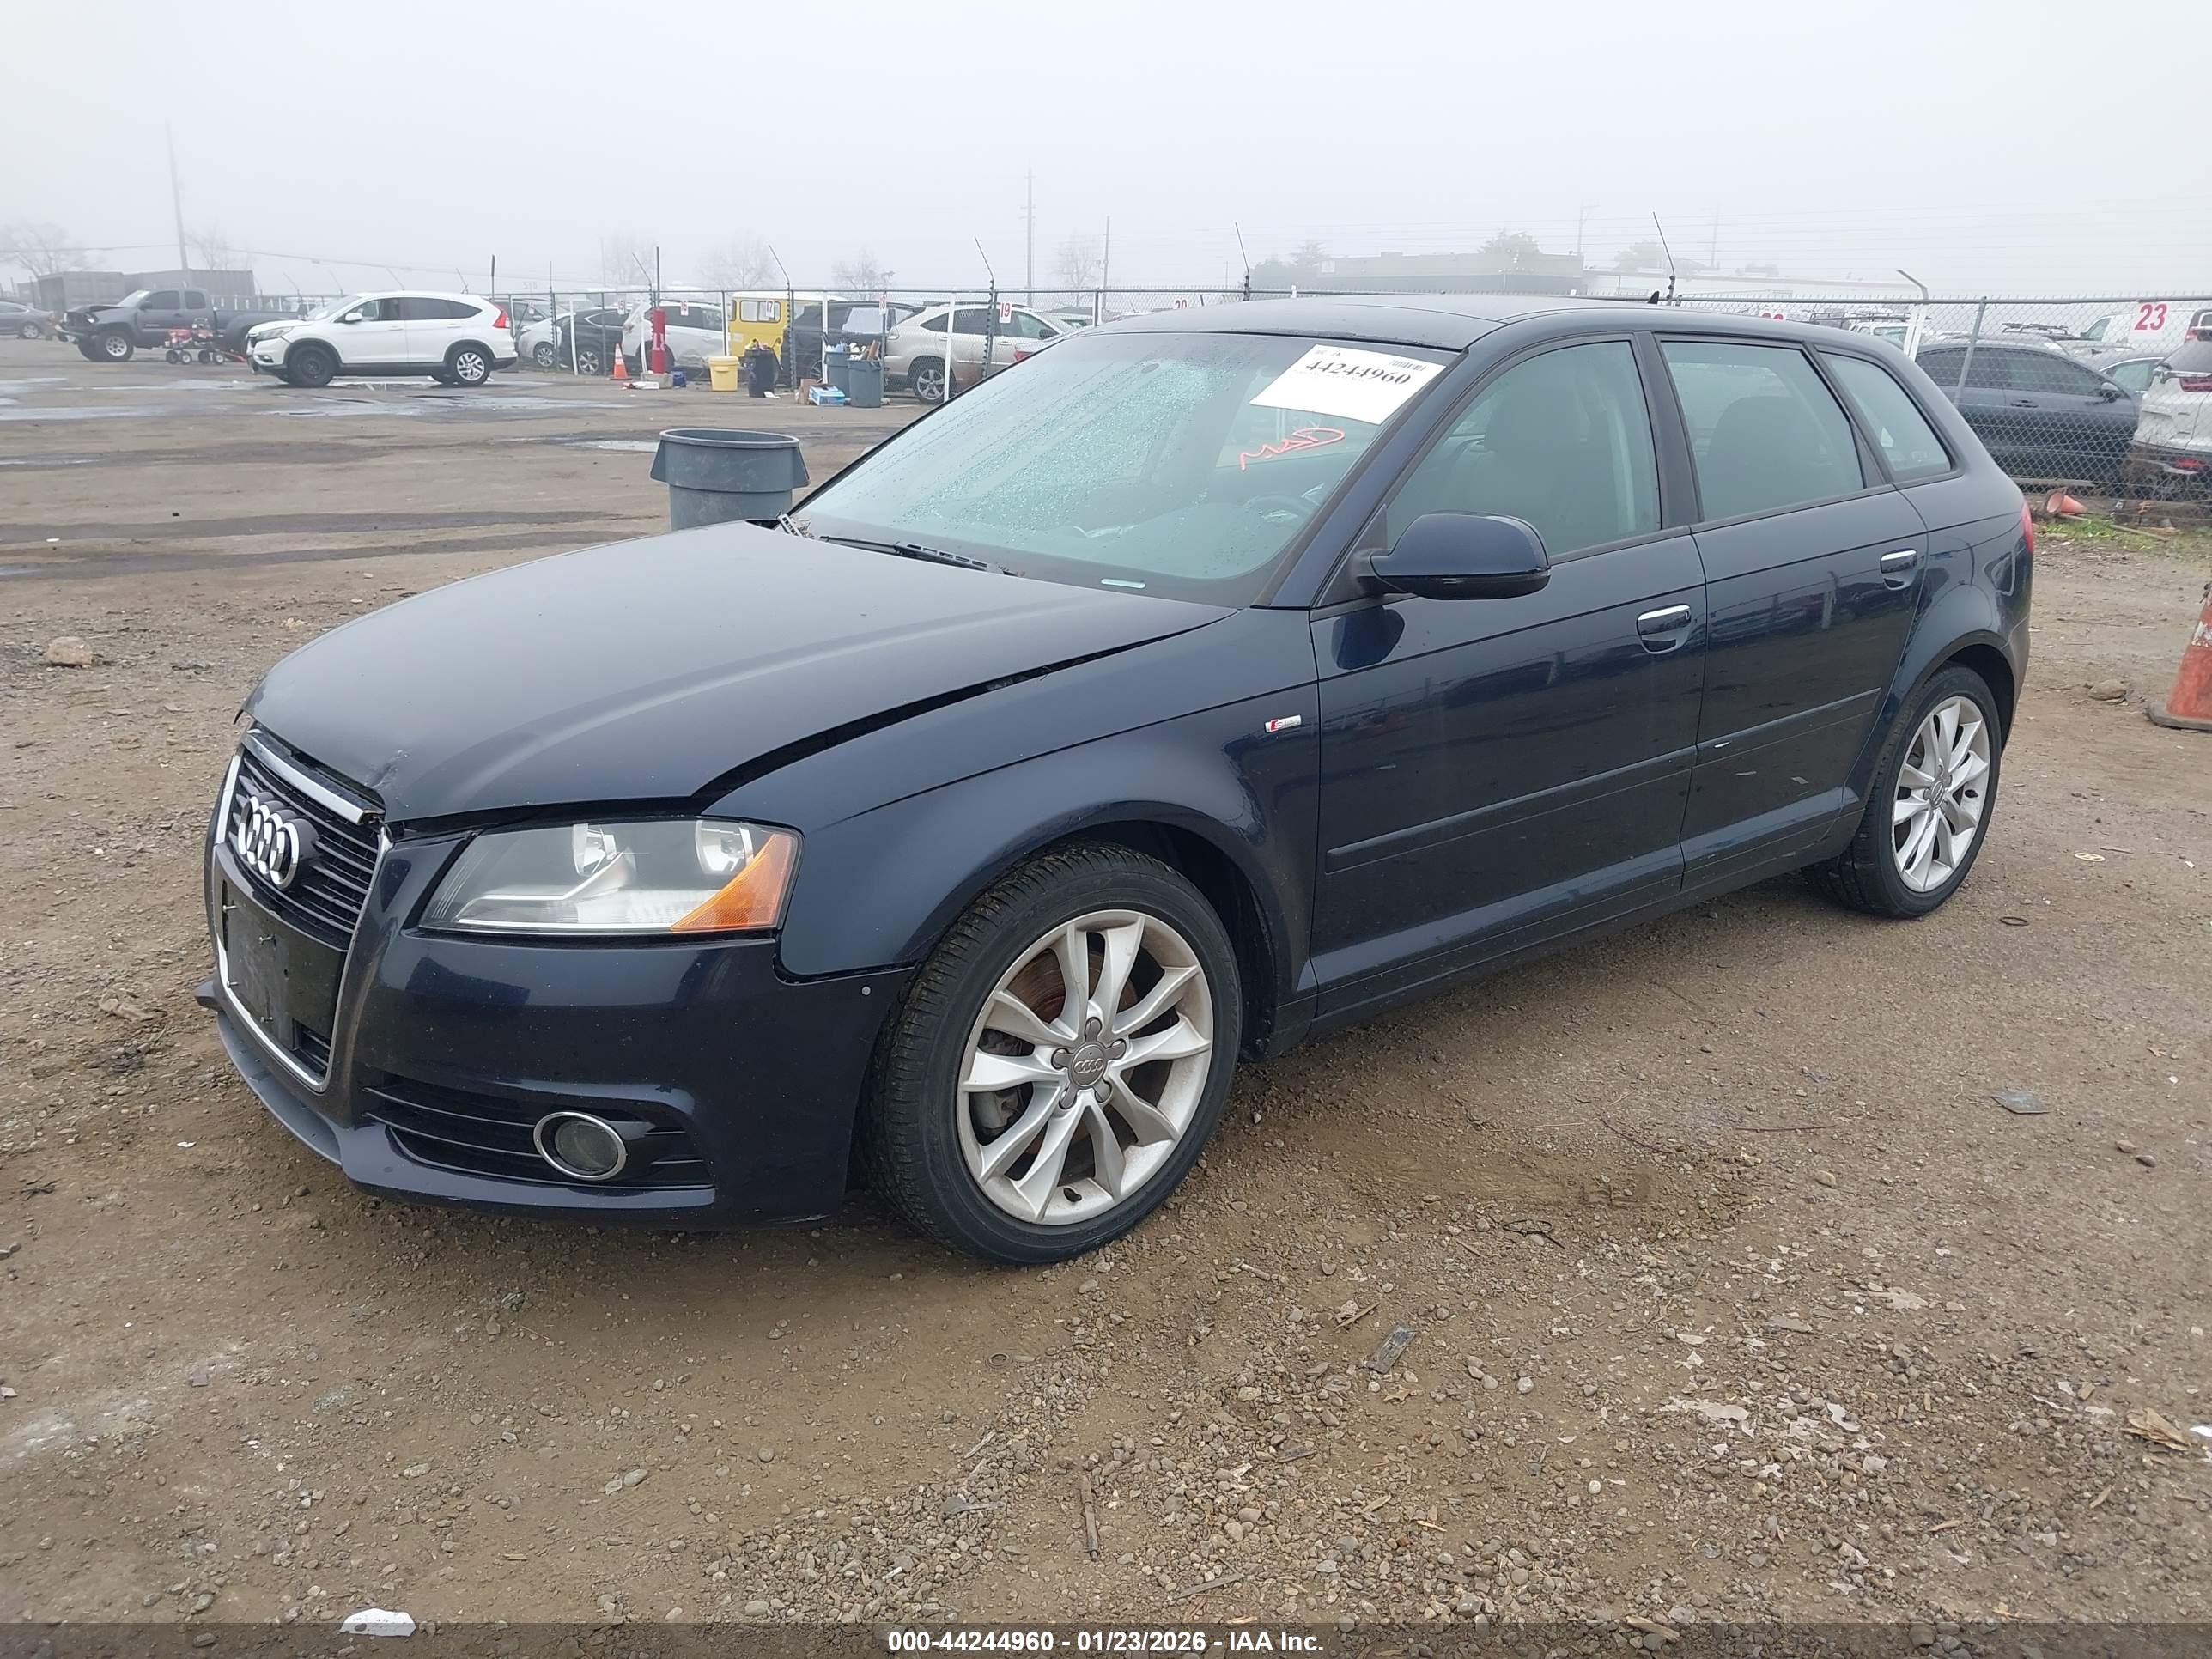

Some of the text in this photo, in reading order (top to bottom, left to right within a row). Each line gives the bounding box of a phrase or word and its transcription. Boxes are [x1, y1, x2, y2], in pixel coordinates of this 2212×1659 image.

[1000, 302, 1011, 318] 19
[2134, 303, 2167, 331] 23
[1305, 360, 1411, 385] 44244960
